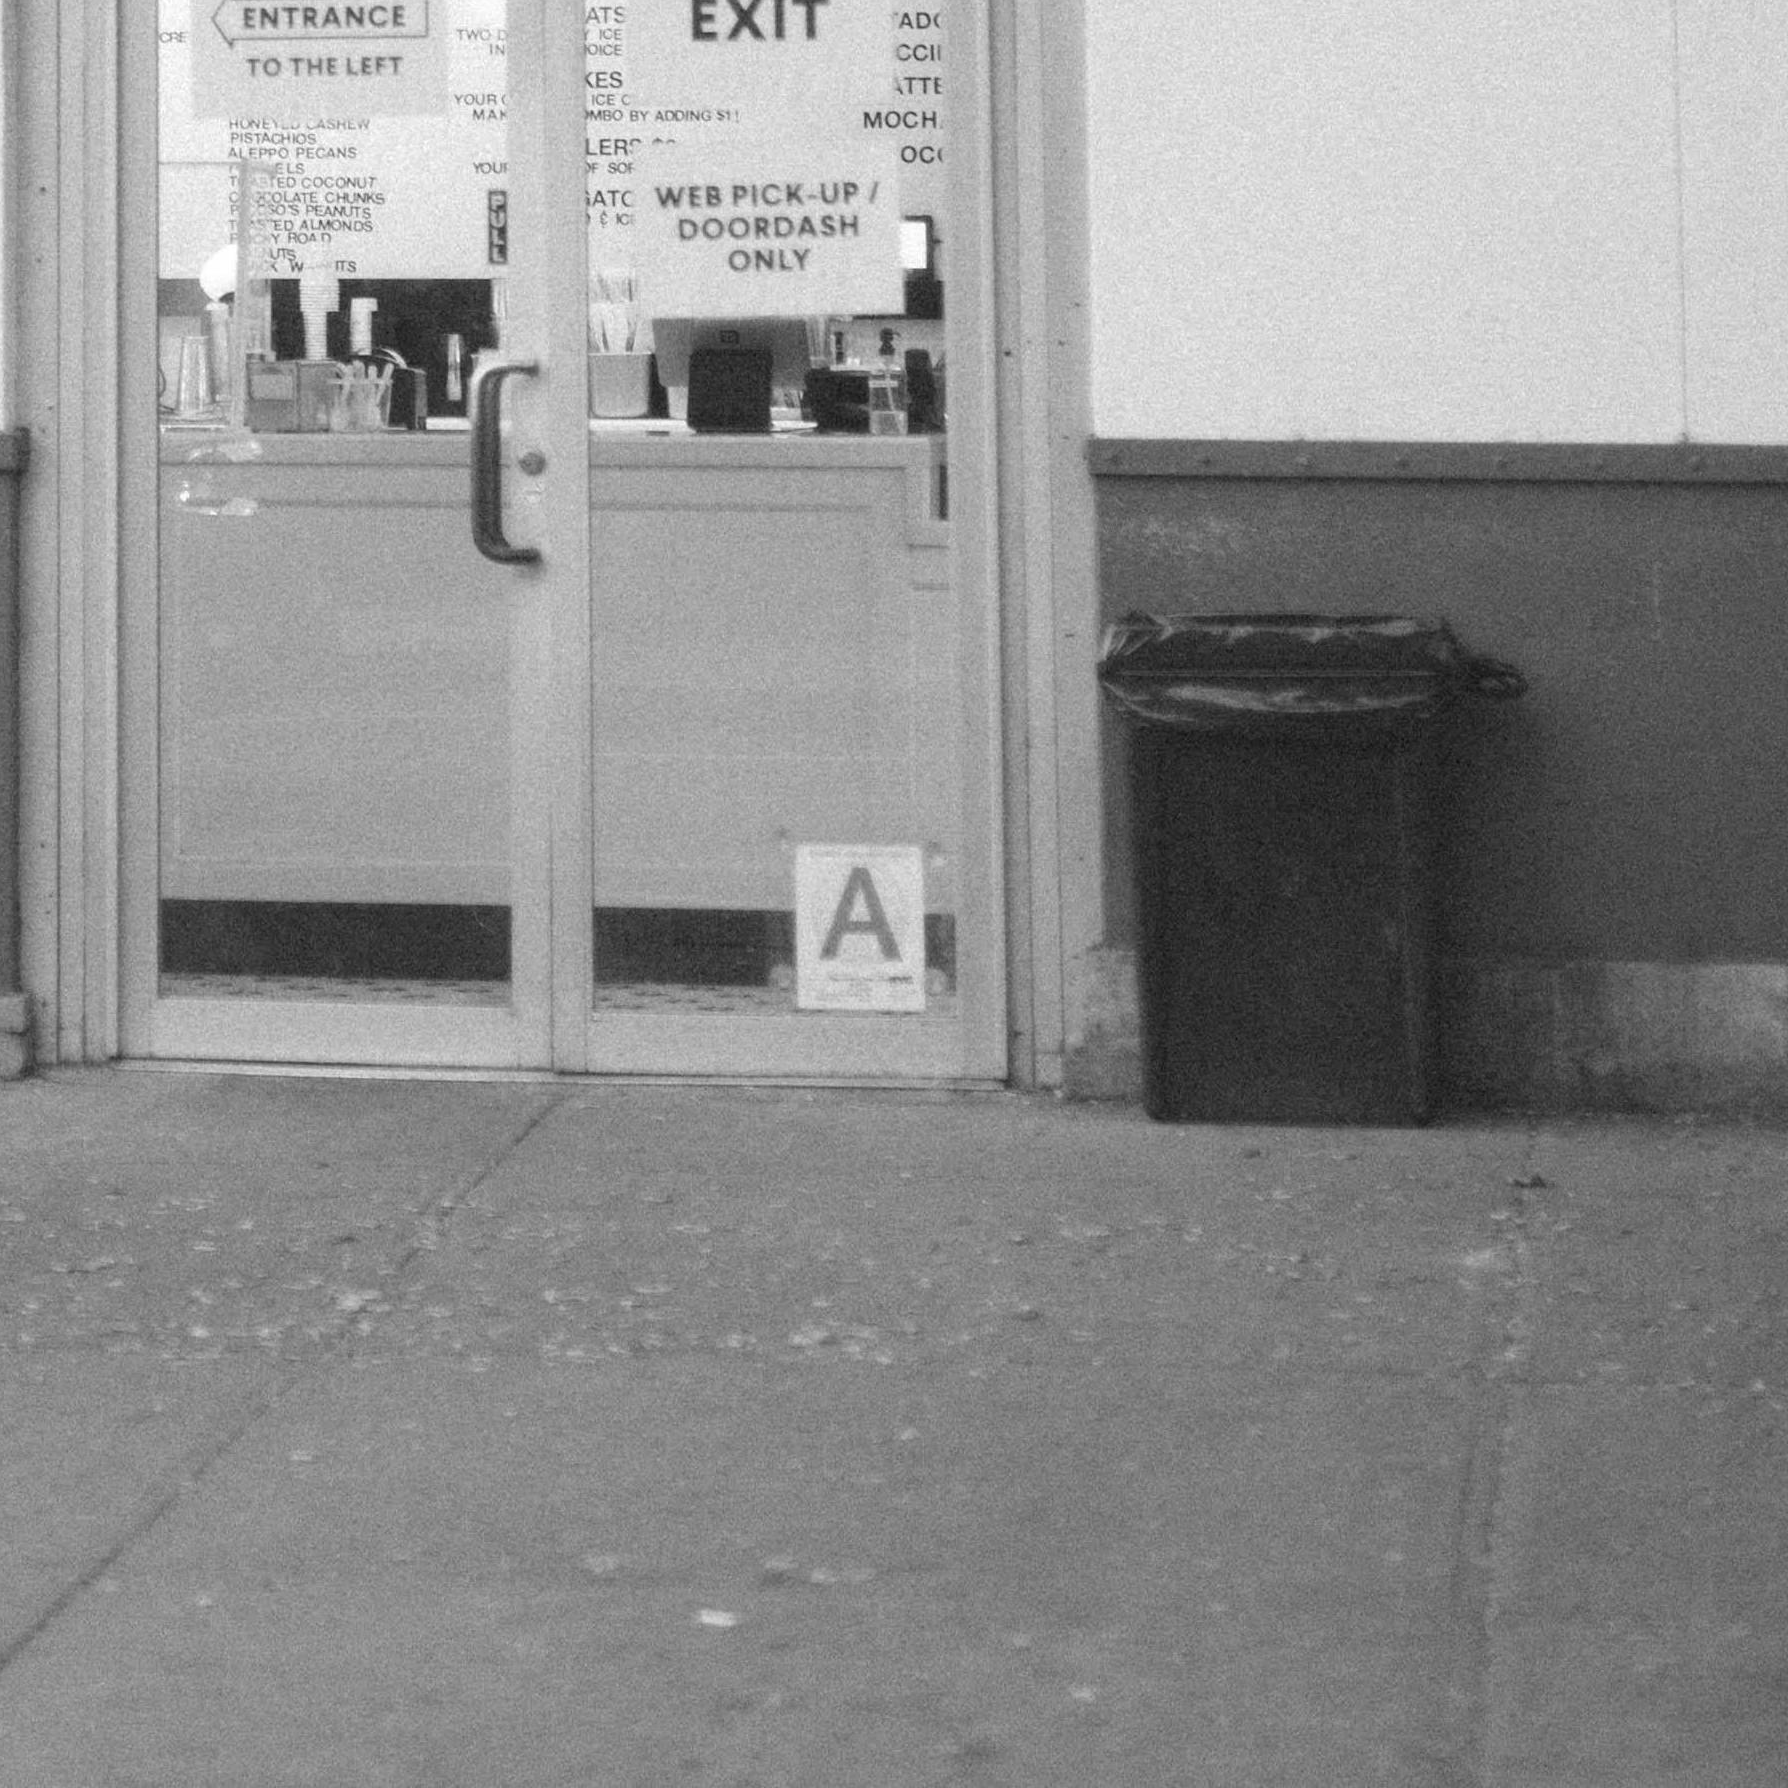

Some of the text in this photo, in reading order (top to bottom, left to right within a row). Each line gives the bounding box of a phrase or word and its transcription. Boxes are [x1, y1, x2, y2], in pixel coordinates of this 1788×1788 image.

[242, 5, 407, 30] ENTRANCE
[246, 55, 404, 77] TO THE LEFT
[629, 110, 649, 122] BY
[655, 110, 712, 122] ADDING
[230, 132, 317, 145] PISTACHIOS
[295, 146, 358, 159] PECANS
[301, 176, 378, 189] COCONUT
[324, 192, 386, 206] CHUNKS
[656, 185, 722, 208] WEB
[731, 182, 859, 206] PICK-UP
[305, 205, 372, 220] PEANUTS
[299, 219, 374, 232] ALMONDS
[678, 215, 860, 241] DOORDASH
[728, 248, 811, 272] ONLY
[819, 867, 904, 962] A
